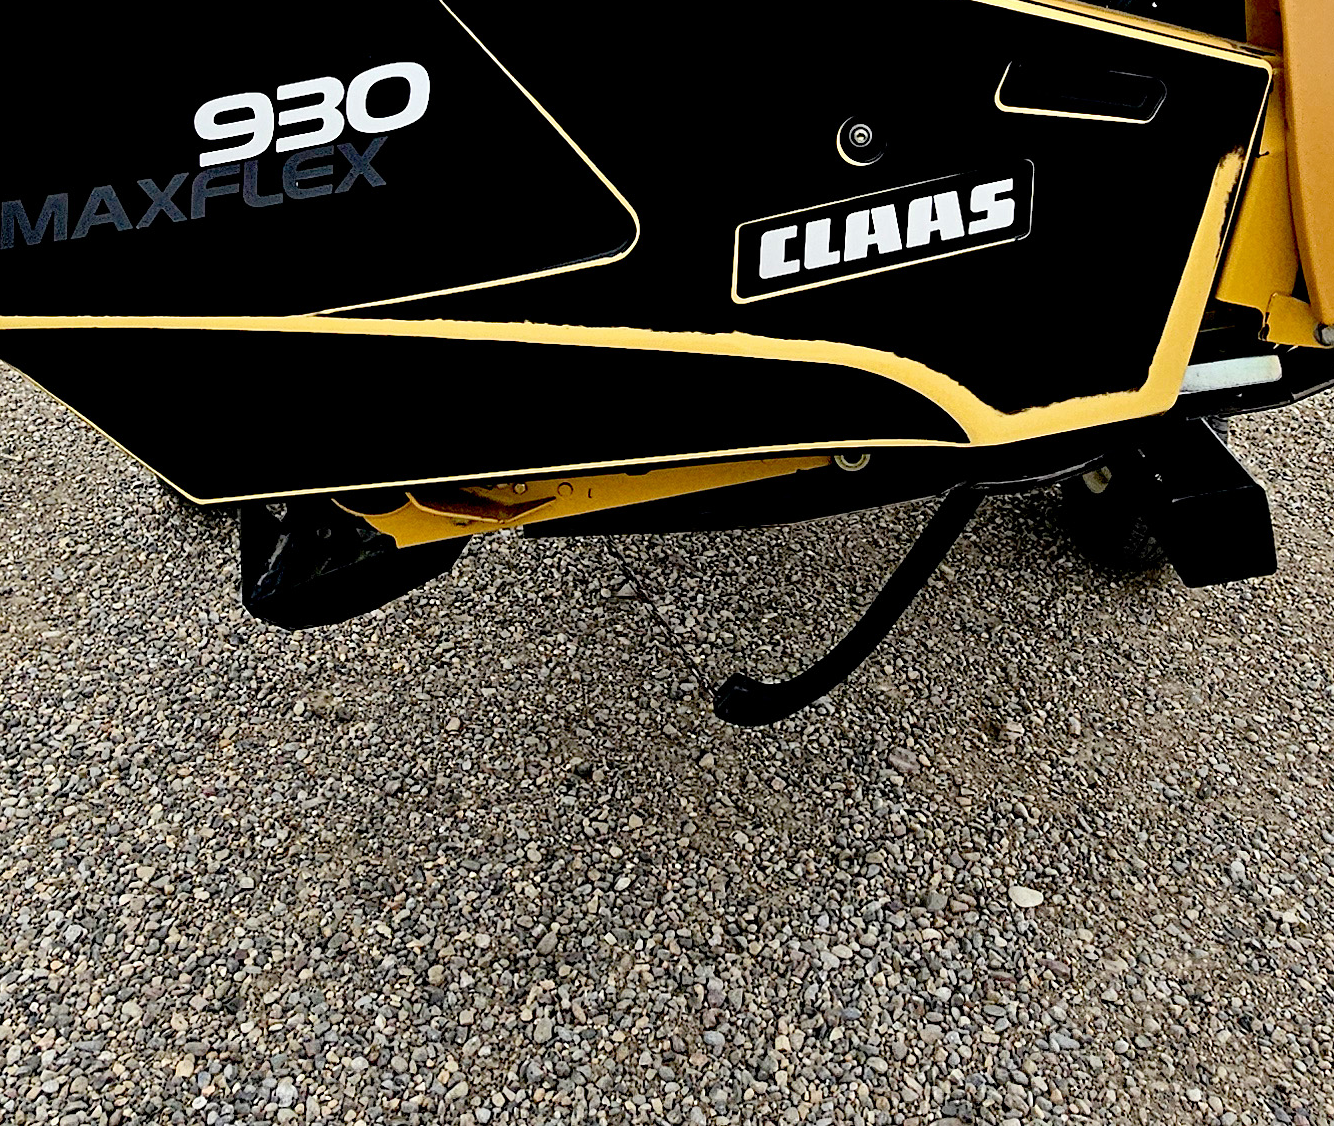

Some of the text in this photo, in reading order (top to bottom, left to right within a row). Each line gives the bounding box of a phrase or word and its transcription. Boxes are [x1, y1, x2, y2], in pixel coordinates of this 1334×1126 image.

[193, 62, 430, 167] 930
[0, 136, 389, 250] MAXFLEX
[759, 178, 1015, 280] CLAAS
